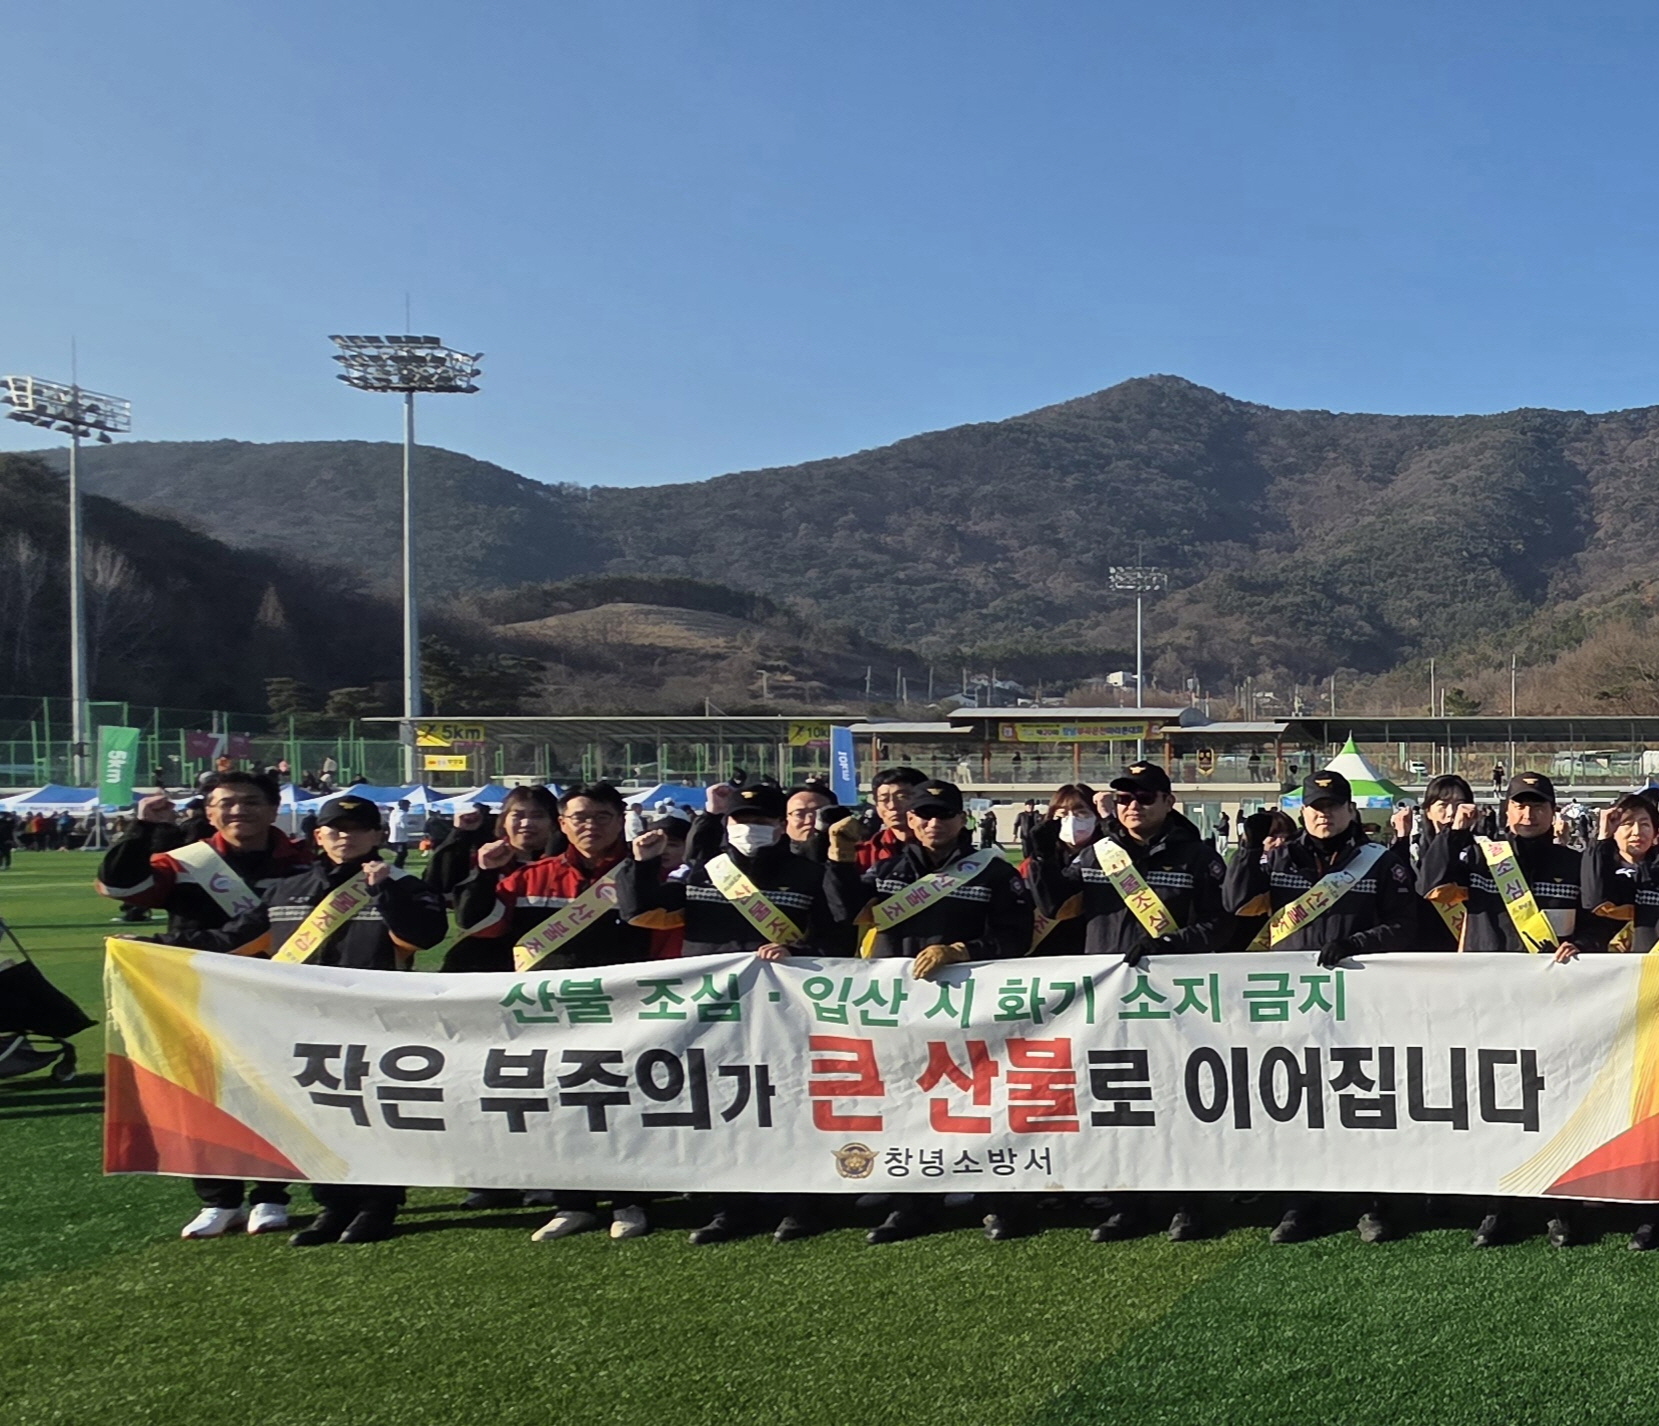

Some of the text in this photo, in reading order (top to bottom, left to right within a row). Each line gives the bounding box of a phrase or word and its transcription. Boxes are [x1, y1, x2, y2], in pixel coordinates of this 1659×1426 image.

[441, 725, 481, 740] 5km
[106, 749, 128, 784] 5km
[500, 977, 614, 1024] 산불
[637, 973, 742, 1023] 조심
[802, 975, 908, 1027] 입산
[925, 976, 976, 1029] 시
[993, 975, 1095, 1025] 화기
[1118, 972, 1222, 1023] 소지
[1242, 971, 1346, 1022] 금지
[293, 1034, 1546, 1134] 작은 부주의가 큰 산불로 이어집니다
[884, 1146, 1053, 1178] 창녕소방서
